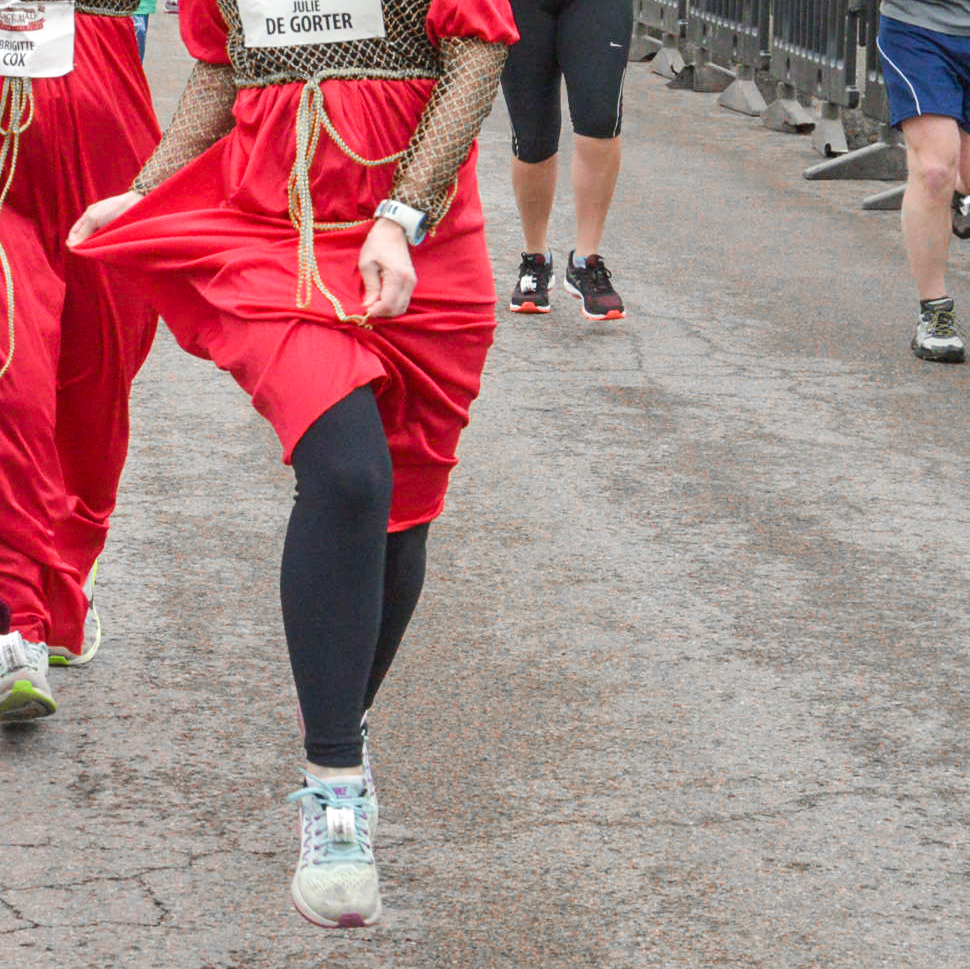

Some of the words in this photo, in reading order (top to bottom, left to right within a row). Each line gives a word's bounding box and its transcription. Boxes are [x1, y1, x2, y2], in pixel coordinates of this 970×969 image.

[293, 0, 321, 13] JULIE
[266, 17, 286, 35] DE
[290, 13, 353, 33] GORTER
[3, 53, 27, 66] COX
